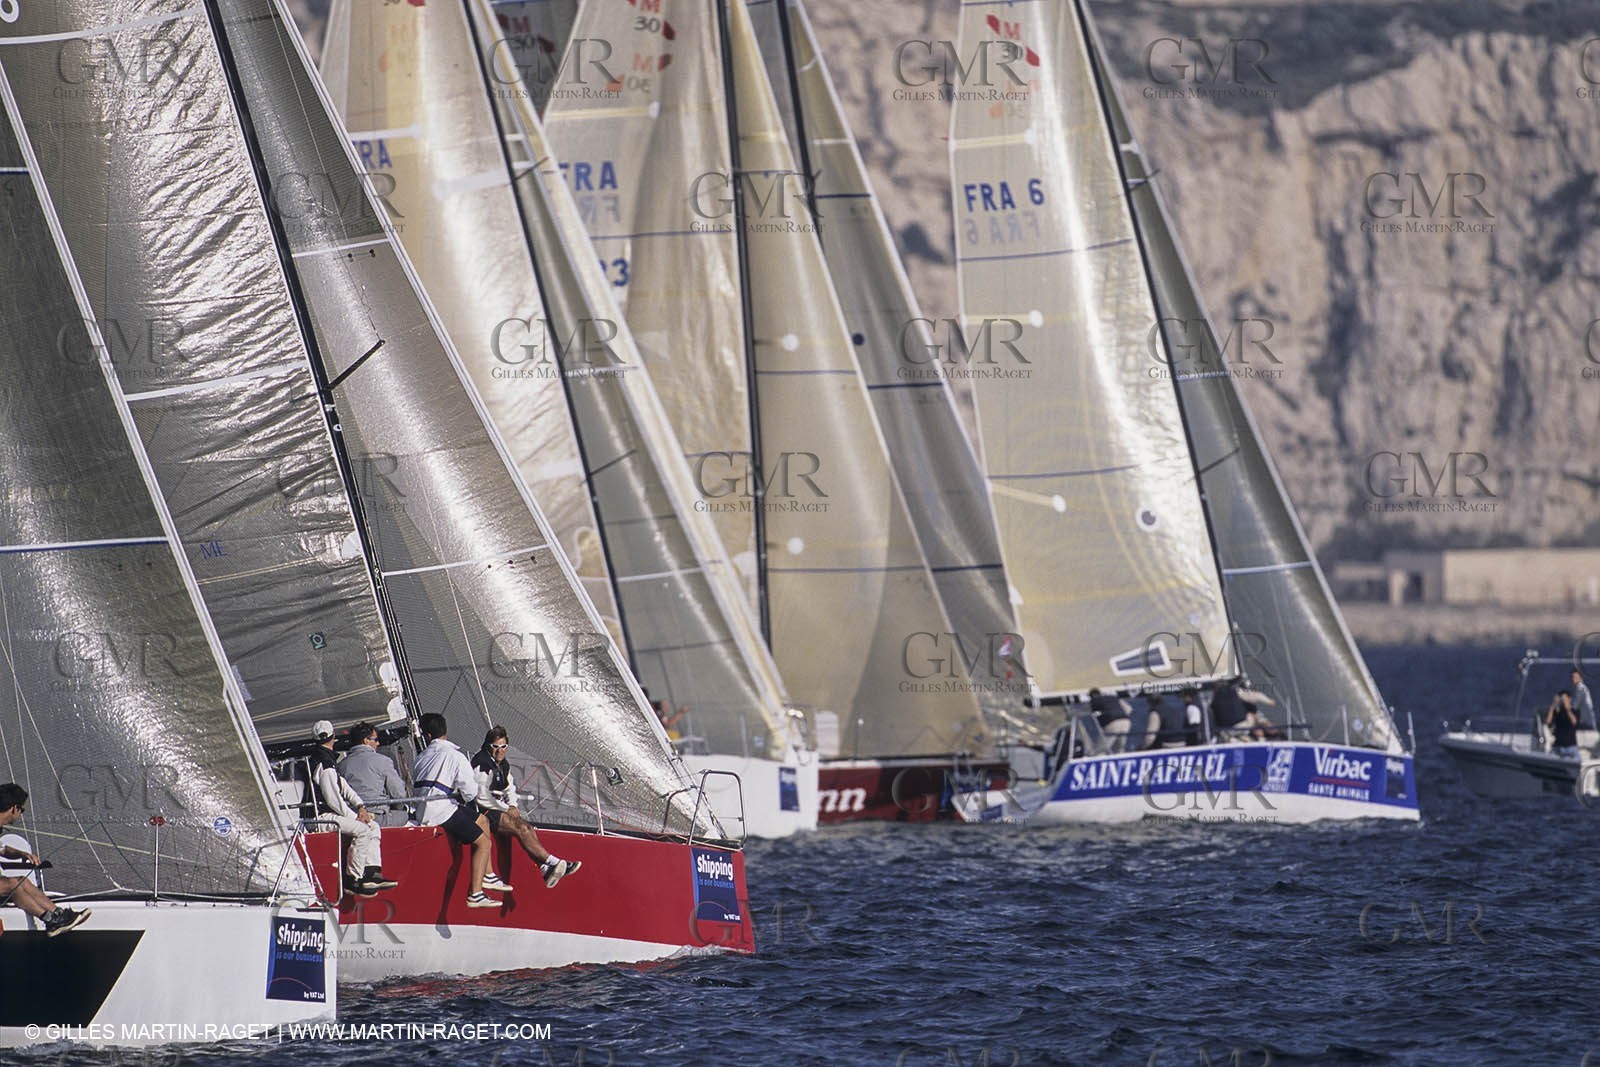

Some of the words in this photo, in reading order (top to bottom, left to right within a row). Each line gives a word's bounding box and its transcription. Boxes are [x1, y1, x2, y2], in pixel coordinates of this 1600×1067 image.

[634, 16, 661, 33] 30
[963, 181, 1016, 212] FRA
[1028, 178, 1045, 206] 6
[1314, 747, 1371, 780] Virbac
[697, 854, 734, 881] Shipping
[277, 923, 325, 953] Shipping
